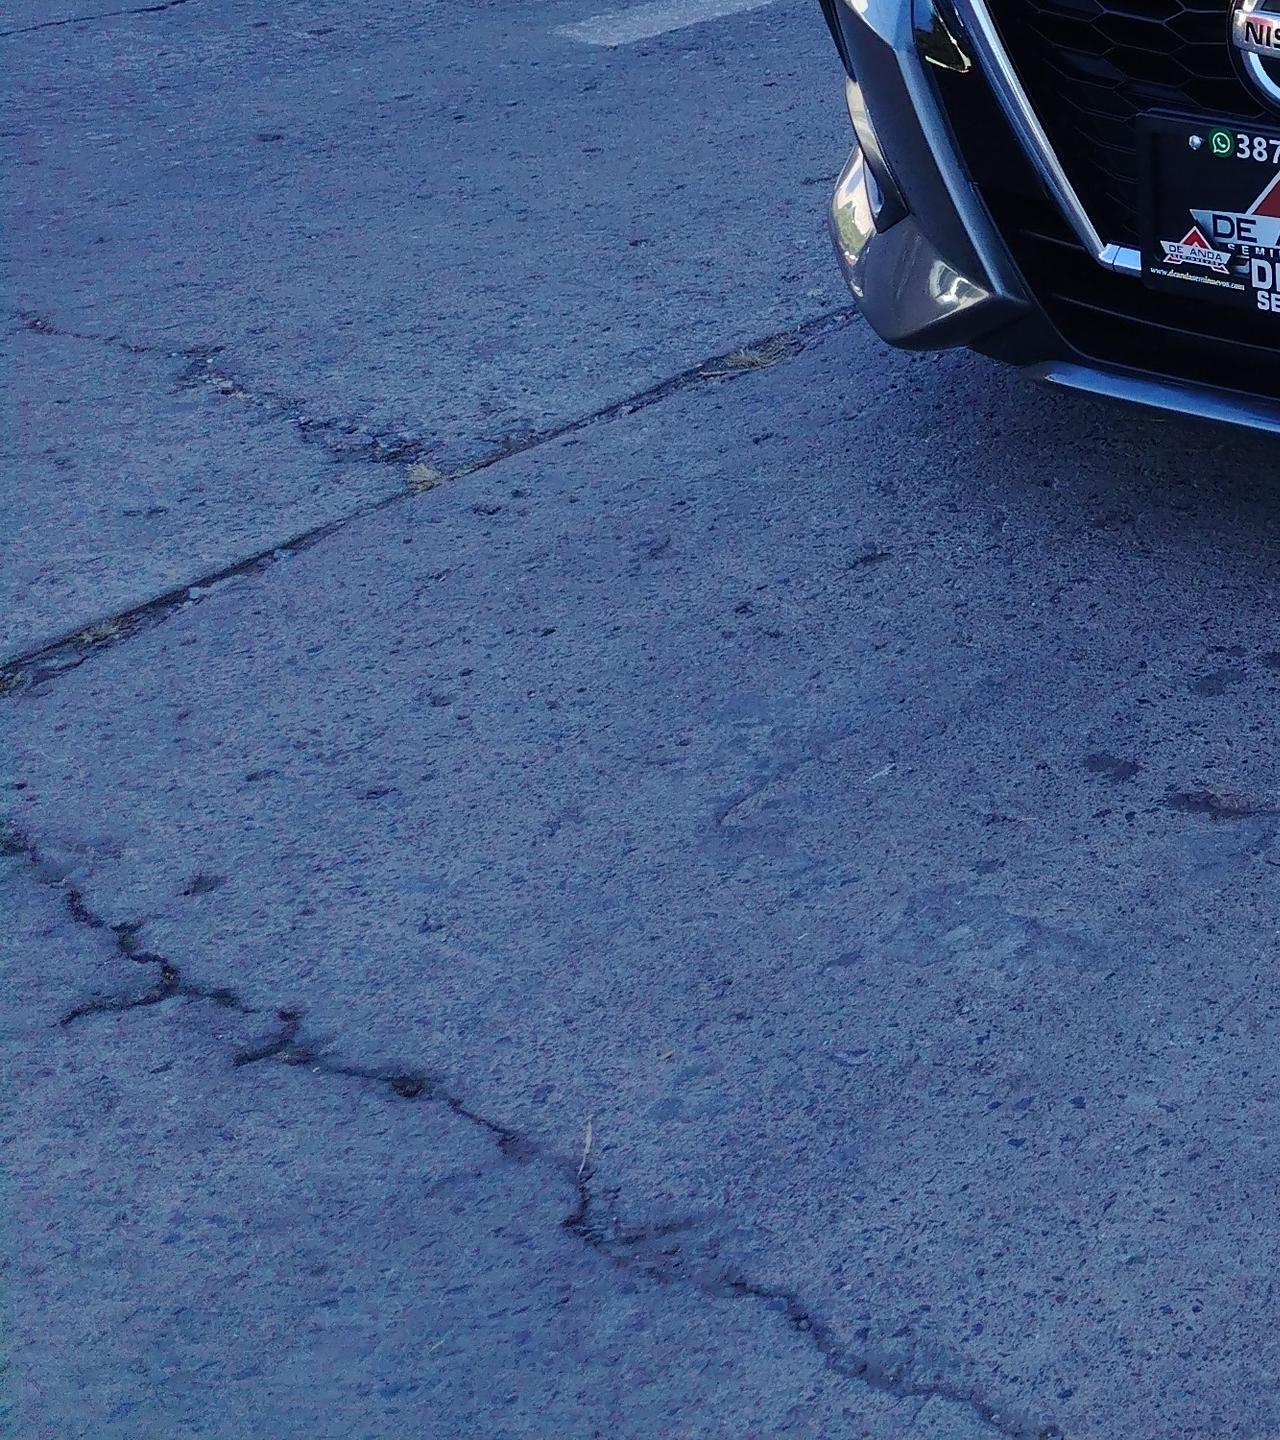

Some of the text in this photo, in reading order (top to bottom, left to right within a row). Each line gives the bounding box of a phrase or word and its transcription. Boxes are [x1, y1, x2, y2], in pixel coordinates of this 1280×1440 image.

[1212, 214, 1257, 243] DE
[1168, 244, 1183, 254] DE
[1190, 248, 1222, 262] ANDA
